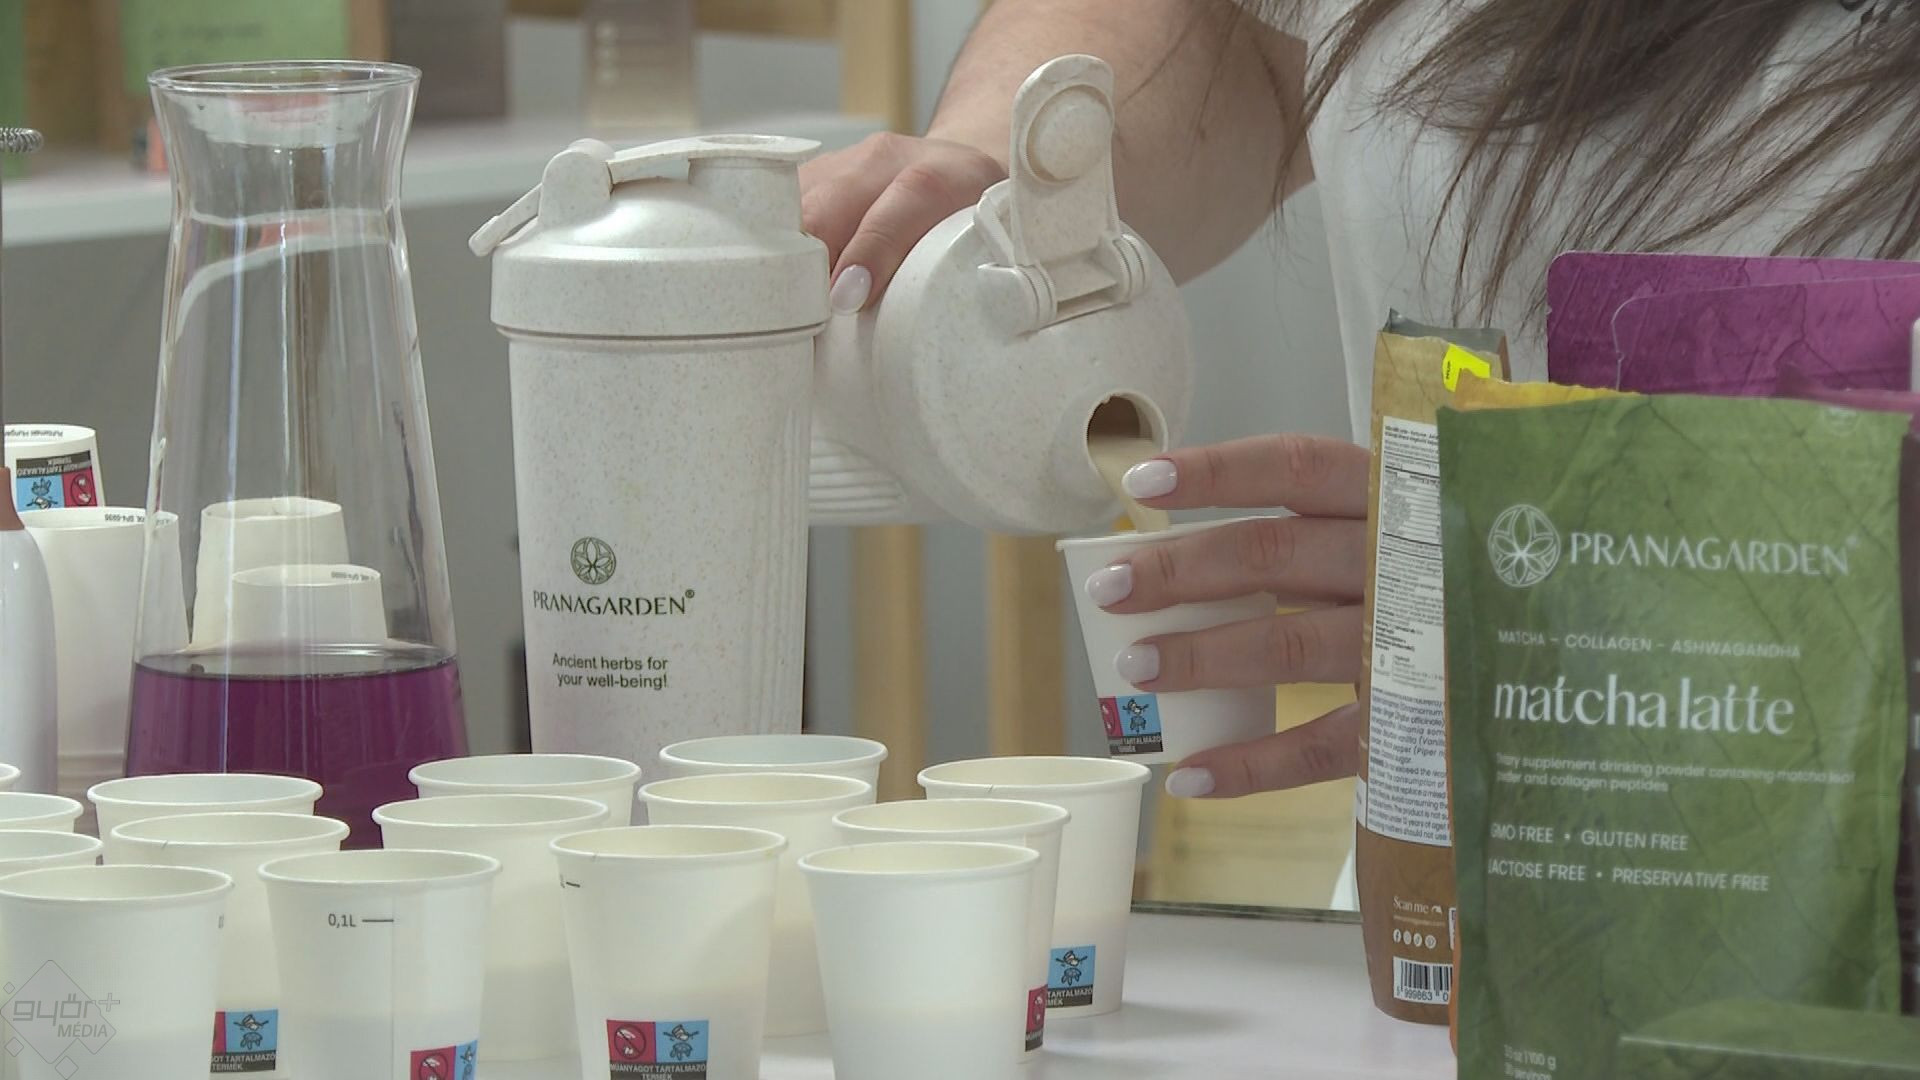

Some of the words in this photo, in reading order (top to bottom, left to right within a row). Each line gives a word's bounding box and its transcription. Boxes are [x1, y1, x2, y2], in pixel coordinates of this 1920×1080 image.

[1498, 630, 1545, 645] MATCHA
[1564, 634, 1652, 652] COLLAGEN
[1670, 640, 1802, 658] ASHWAGANDHA
[552, 653, 597, 669] Ancient
[601, 655, 642, 670] herbs
[648, 657, 668, 670] for
[557, 674, 582, 687] your
[587, 675, 668, 690] well-being!
[1494, 673, 1667, 728] matcha
[1679, 677, 1795, 735] latte
[1522, 756, 1596, 772] supplement
[1600, 761, 1653, 776] drinking
[1656, 763, 1706, 780] powder
[1523, 773, 1548, 785] and
[1550, 774, 1607, 791] collagen
[1610, 777, 1668, 793] peptides
[1491, 823, 1516, 839] GMO
[1519, 825, 1554, 843] FREE
[1581, 830, 1649, 848] GLUTEN
[1652, 833, 1689, 851] FREE
[1488, 859, 1543, 878] LACTOSE
[1548, 863, 1587, 881] FREE
[1612, 867, 1727, 889] PRESERVATIVE
[1732, 873, 1769, 891] FREE
[1394, 896, 1413, 911] Scan
[1414, 902, 1429, 914] me
[327, 913, 357, 928] 0,1L
